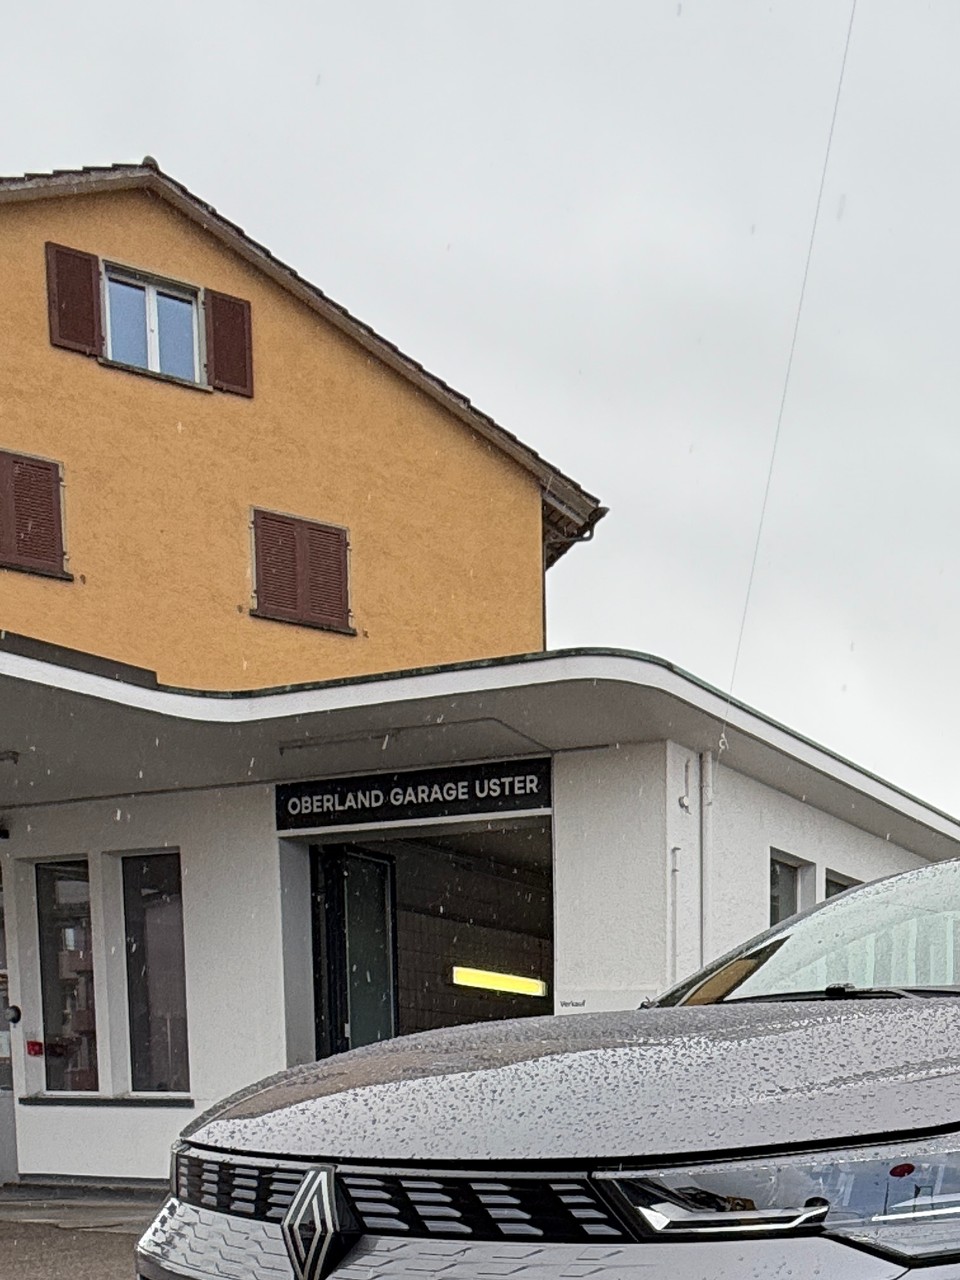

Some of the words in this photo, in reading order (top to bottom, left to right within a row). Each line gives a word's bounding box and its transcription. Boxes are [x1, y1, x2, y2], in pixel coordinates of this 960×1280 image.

[287, 789, 384, 815] OBERLAND
[390, 781, 469, 806] GARAGE
[475, 774, 539, 799] USTER
